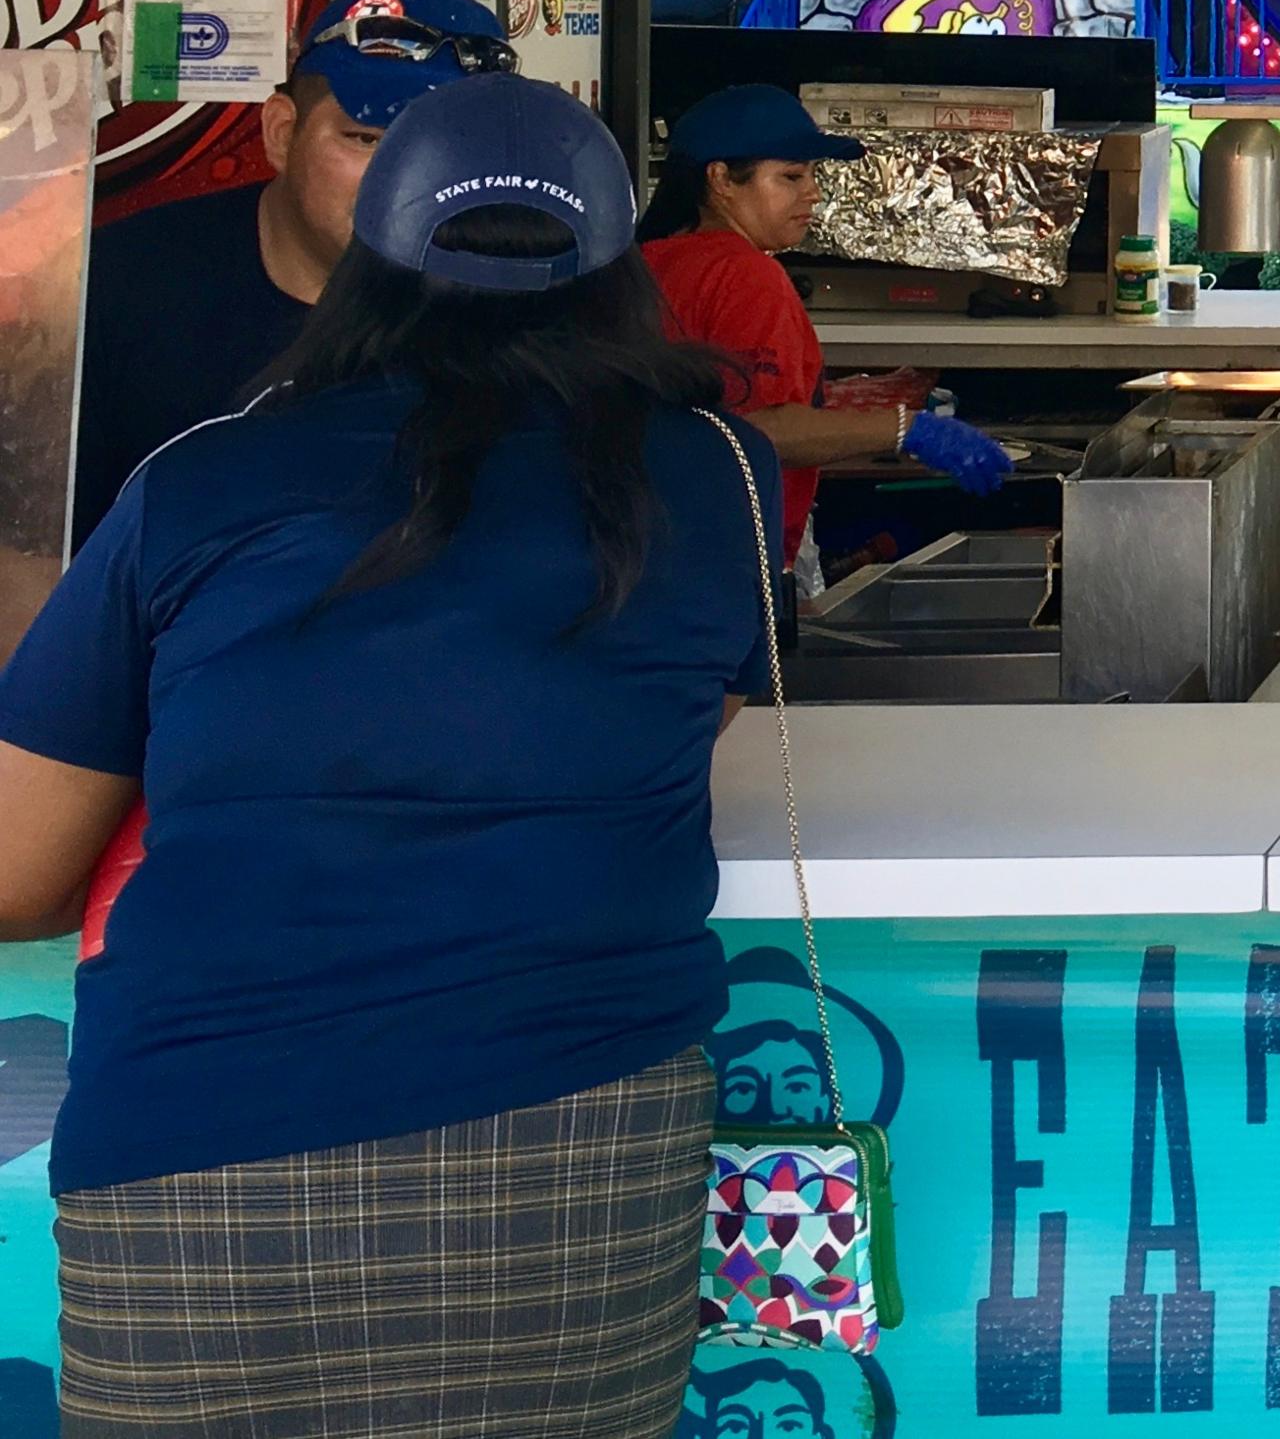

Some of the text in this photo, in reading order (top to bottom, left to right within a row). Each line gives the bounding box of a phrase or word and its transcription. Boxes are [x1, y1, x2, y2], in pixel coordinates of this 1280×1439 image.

[564, 13, 599, 36] TEXAS
[435, 175, 585, 213] STATE FAIR TEXAS
